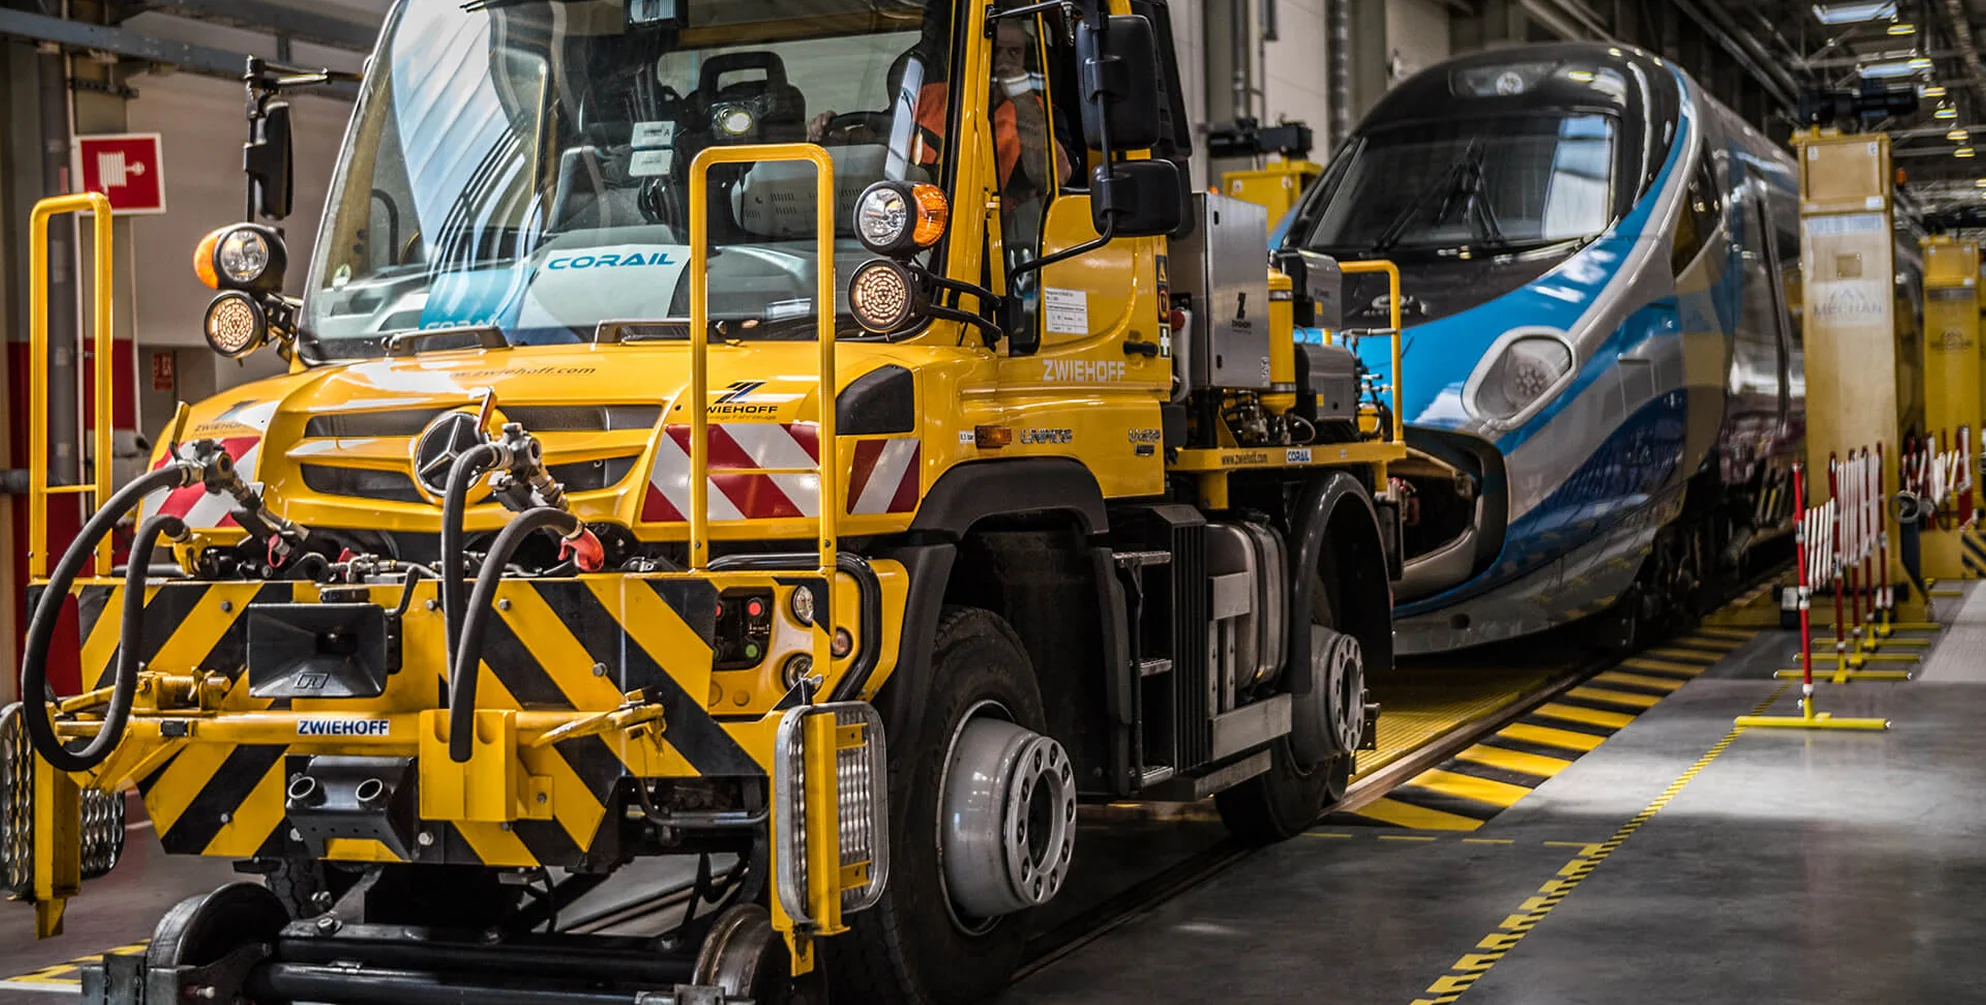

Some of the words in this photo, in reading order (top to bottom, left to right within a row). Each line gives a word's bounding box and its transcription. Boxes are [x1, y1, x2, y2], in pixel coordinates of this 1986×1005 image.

[549, 253, 675, 270] CORAIL
[1043, 360, 1126, 382] ZWIEHOFF
[706, 405, 778, 414] WIEHOFF
[1287, 450, 1310, 462] CORAIL
[299, 720, 389, 735] ZWIEHOFF
